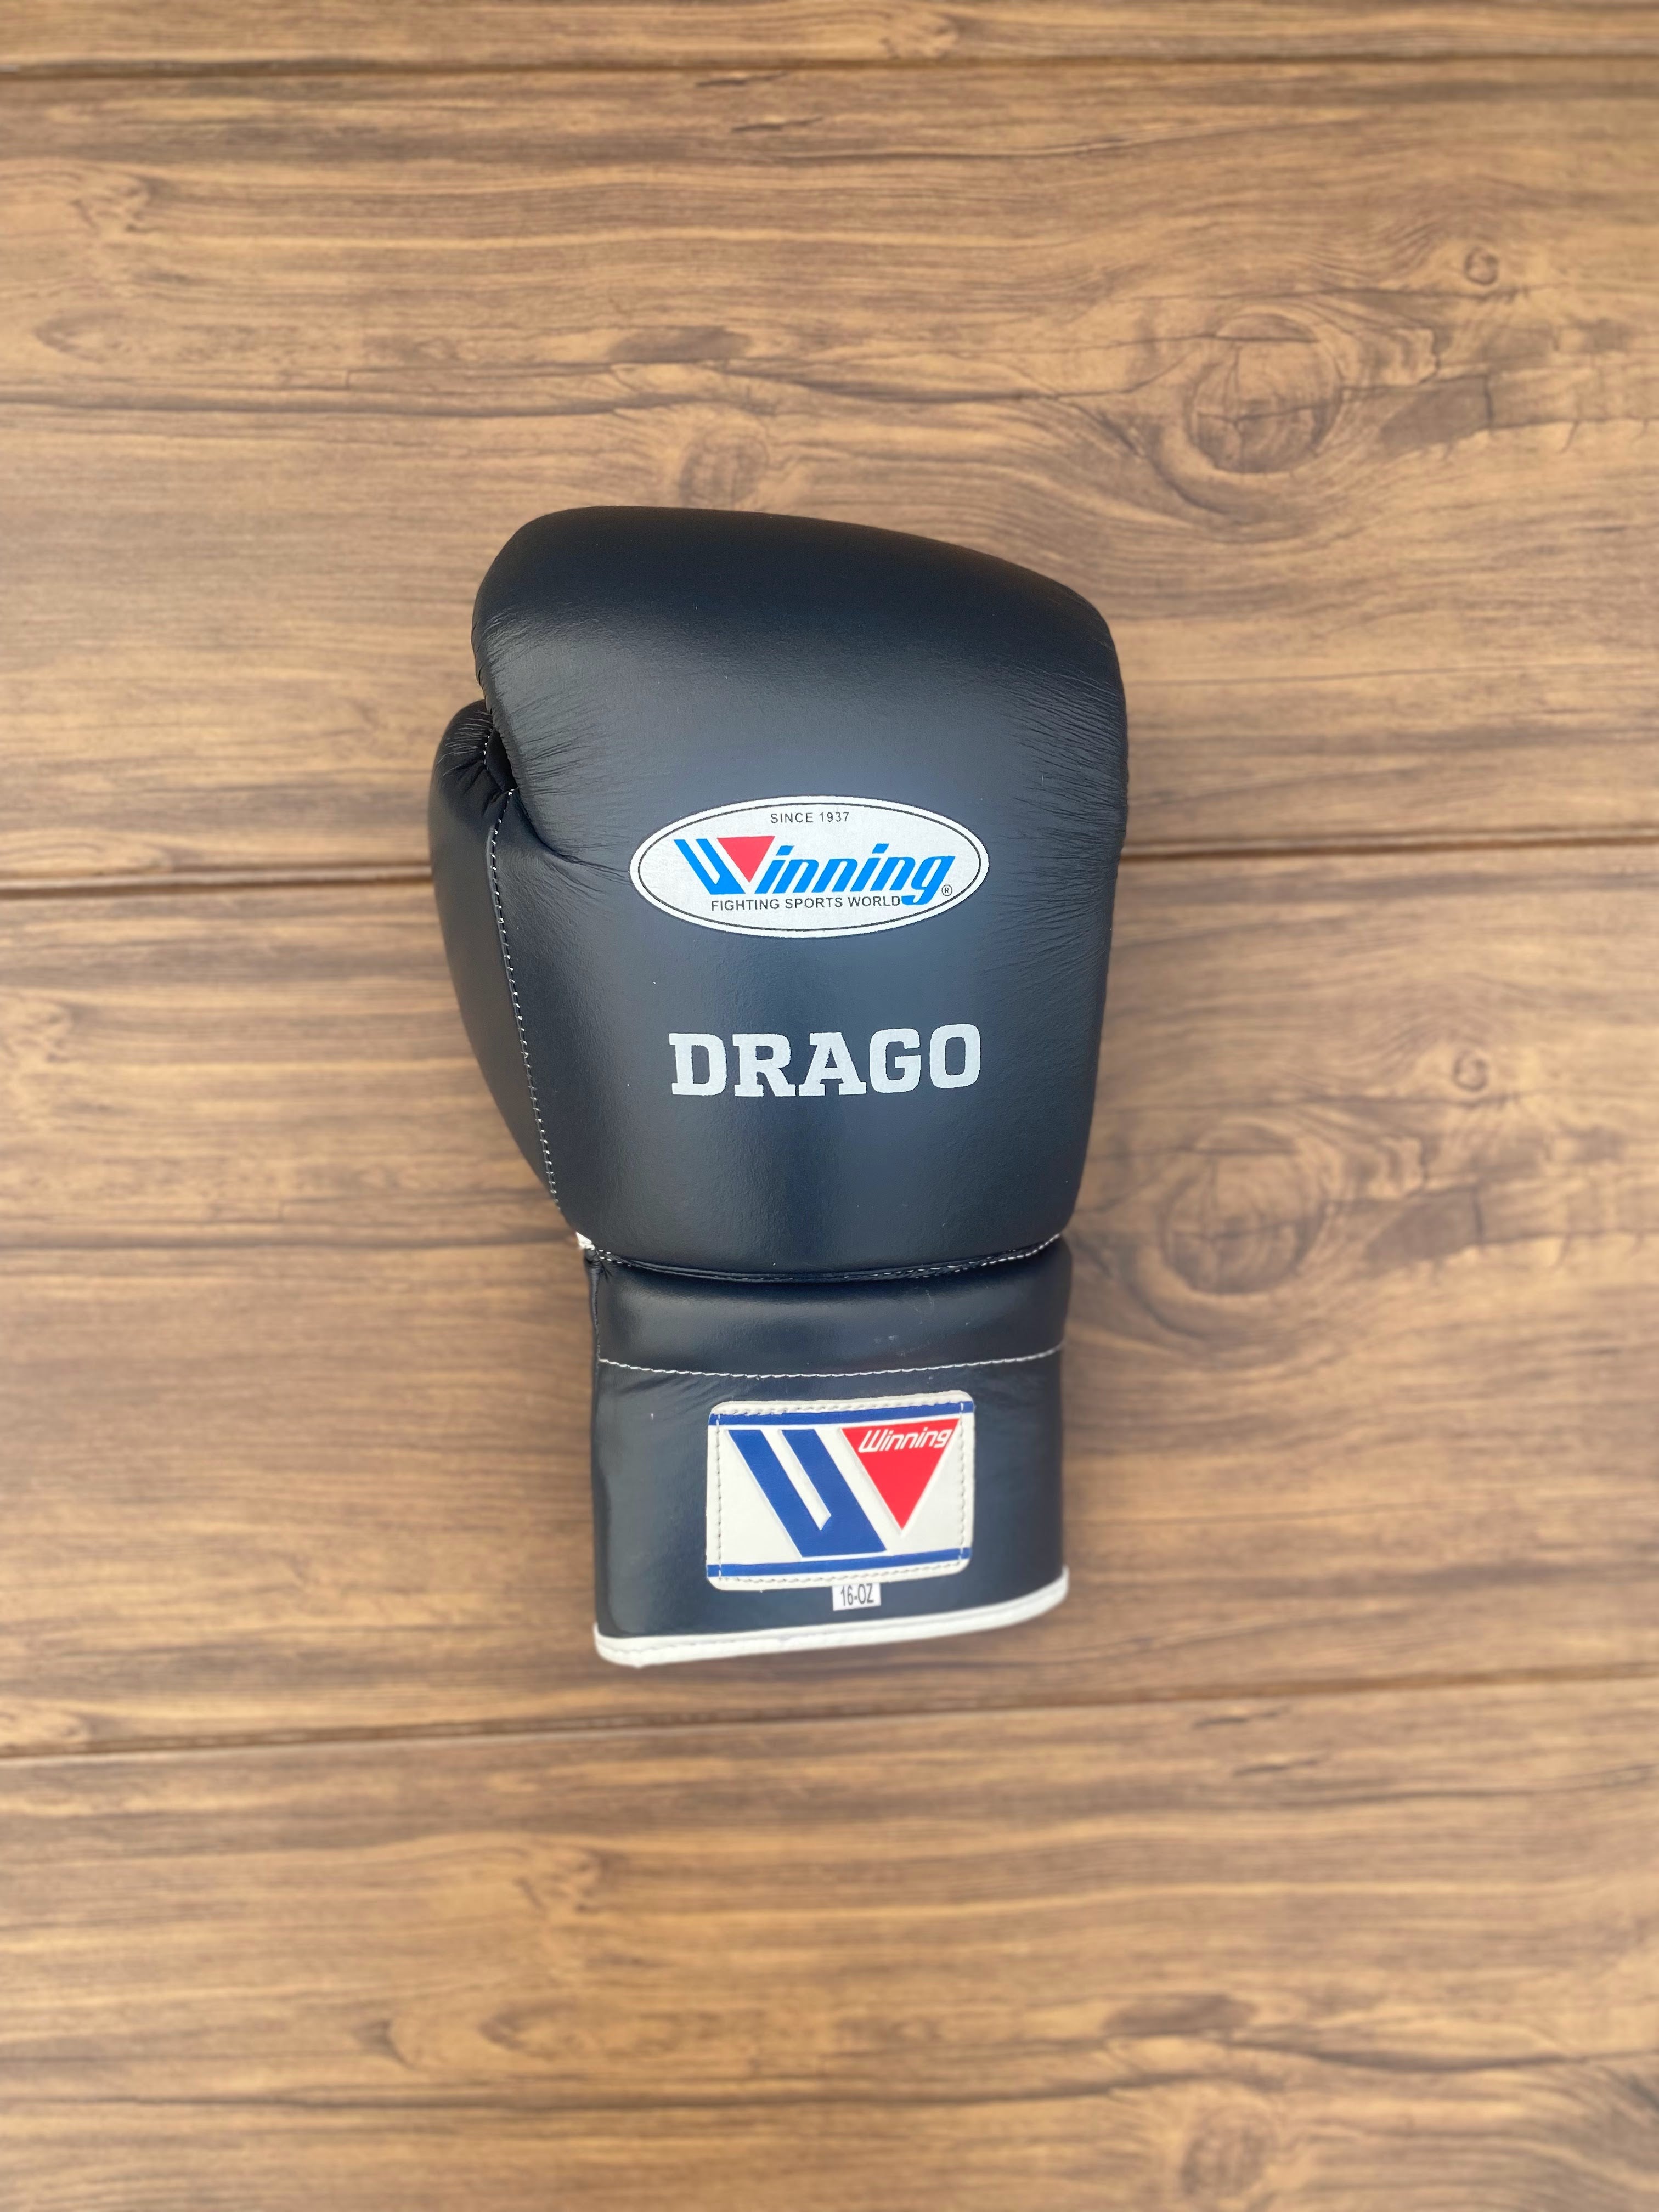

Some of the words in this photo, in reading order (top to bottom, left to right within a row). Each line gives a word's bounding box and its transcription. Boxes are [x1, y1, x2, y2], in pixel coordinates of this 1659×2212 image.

[770, 812, 814, 823] SINCE
[820, 811, 850, 822] 1937
[674, 836, 955, 905] Winning
[712, 899, 780, 911] FIGHTING
[785, 897, 843, 909] SPORTS
[848, 895, 900, 907] WORLD
[669, 1024, 981, 1097] DRAGO
[858, 1427, 953, 1453] Winning
[840, 1583, 874, 1607] 16-OZ
